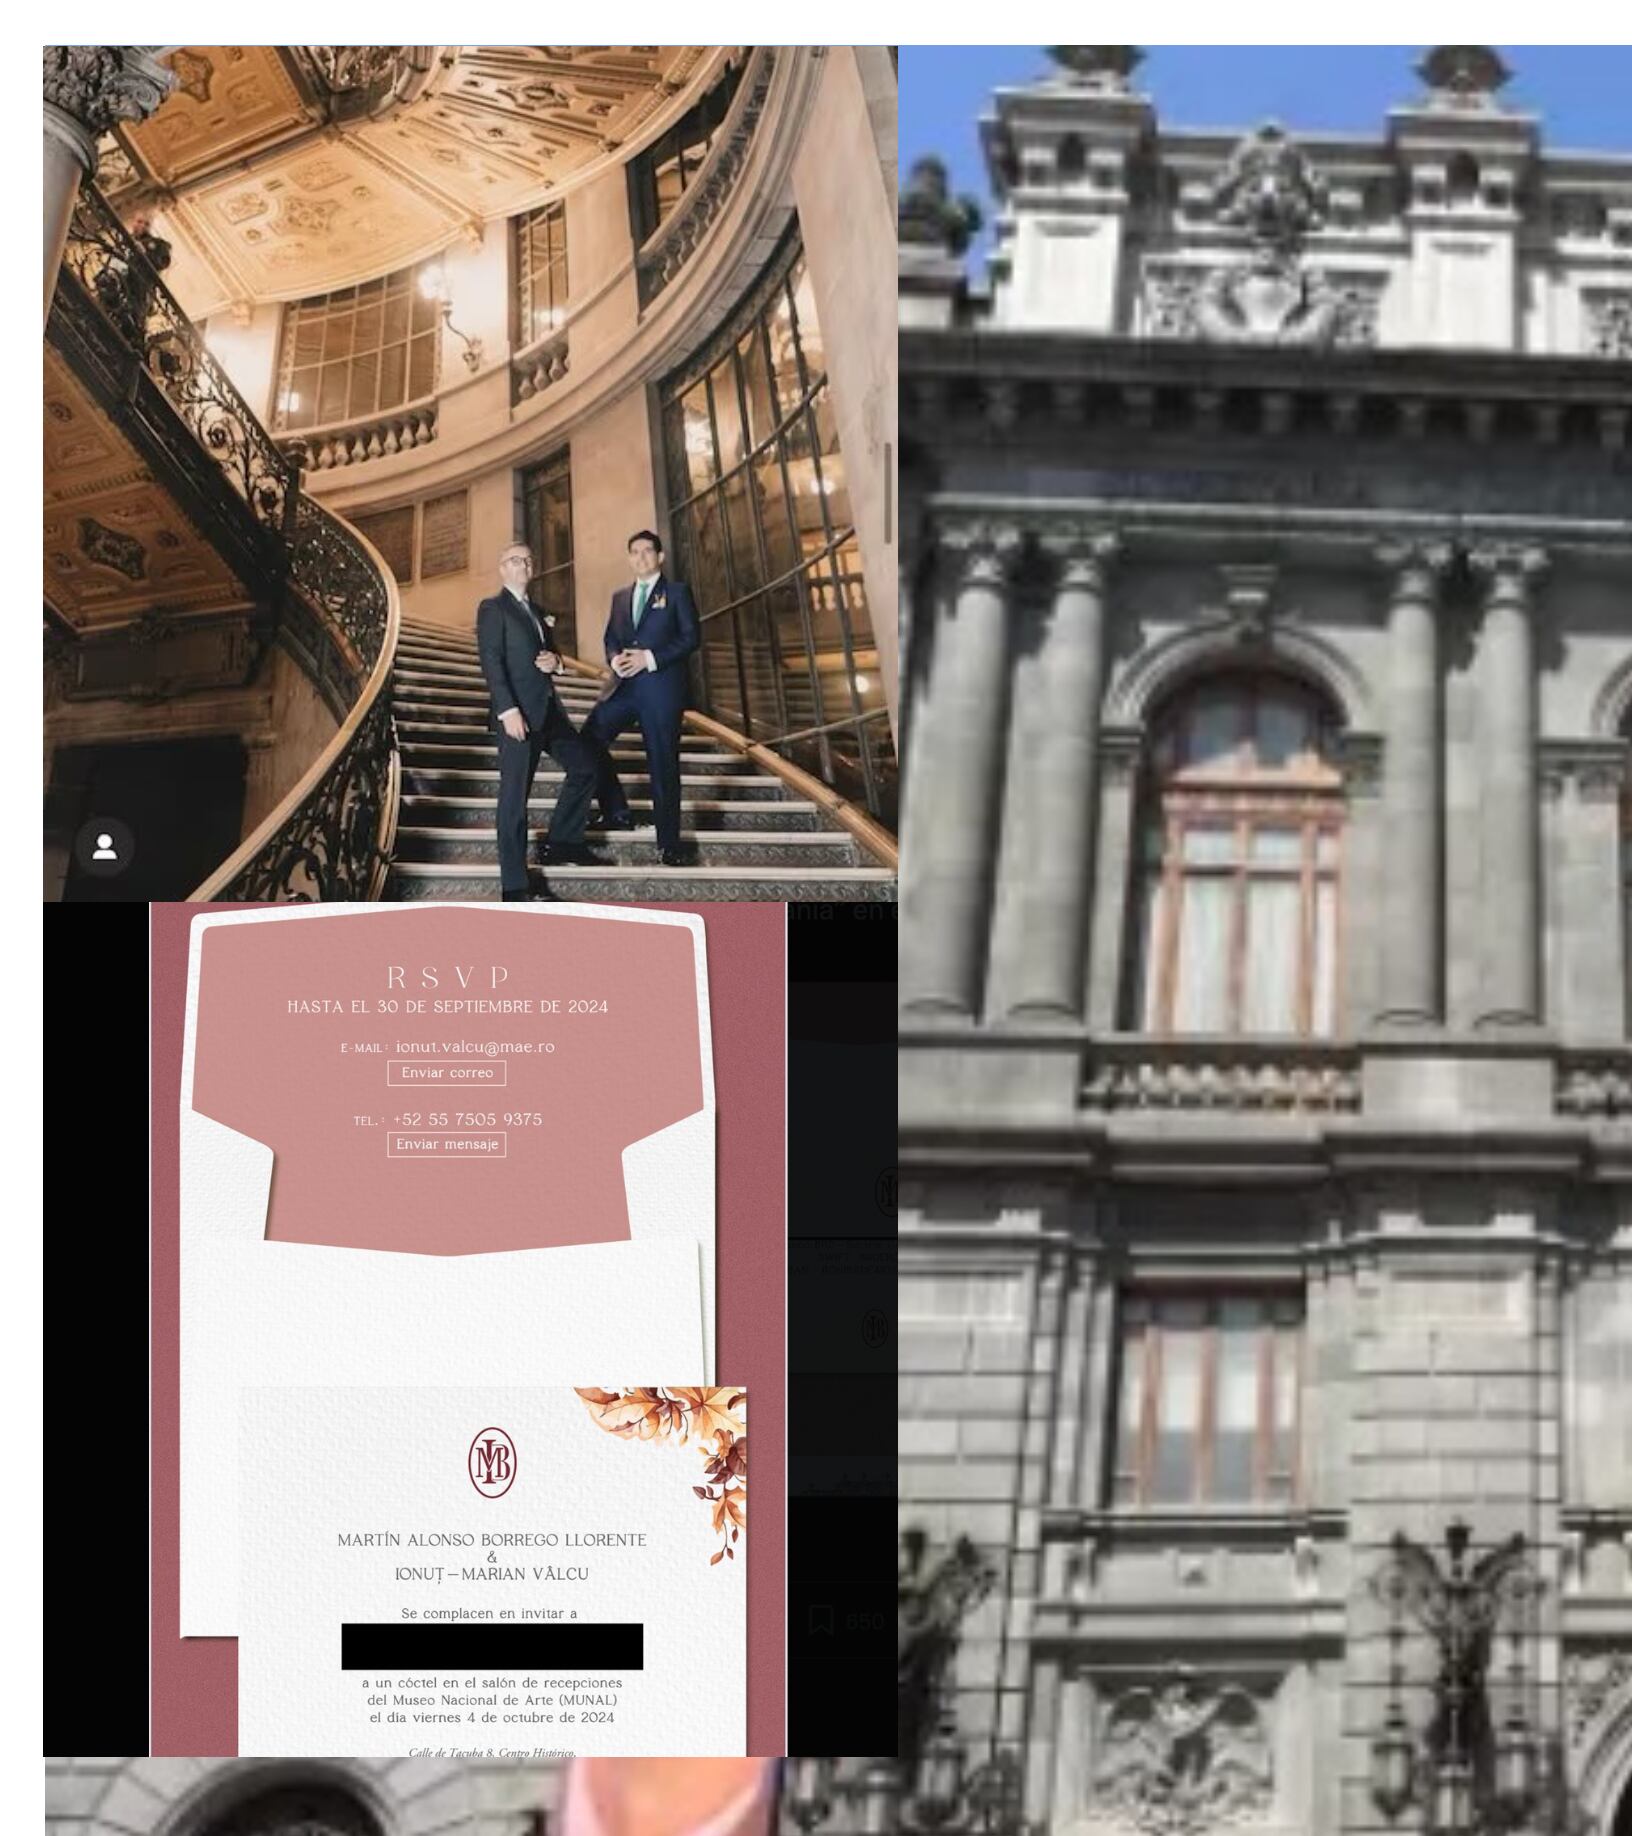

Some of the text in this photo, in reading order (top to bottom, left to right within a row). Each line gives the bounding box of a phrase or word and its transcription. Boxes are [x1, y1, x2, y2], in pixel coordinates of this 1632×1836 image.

[287, 999, 609, 1014] HASTA EL 30 DE SEPTIEMBRE DE 2024
[396, 1039, 555, 1057] ionut.valcu@mae.ro
[402, 1066, 494, 1080] Enviar correo
[393, 1112, 422, 1126] +52
[428, 1112, 449, 1126] 55
[455, 1112, 496, 1127] 7505
[503, 1112, 543, 1126] 9375
[396, 1138, 499, 1152] Enviar mensaje
[338, 1530, 647, 1547] MARTÍN ALONSO BORREGO LLORENTE
[486, 1550, 497, 1564] &
[532, 1565, 589, 1581] VÂLCU
[401, 1607, 578, 1622] Se complacen en invitar a
[362, 1676, 623, 1692] a un cóctel en el salón de recepciones
[367, 1694, 618, 1707] del Museo Nacional de Arte (MUNAL)
[369, 1711, 381, 1723] el
[412, 1711, 461, 1723] viernes
[467, 1711, 476, 1723] 4
[481, 1711, 497, 1723] de
[502, 1711, 554, 1724] octubre
[559, 1711, 576, 1723] de
[581, 1711, 615, 1723] 2024
[408, 1747, 434, 1757] Calle
[435, 1747, 447, 1757] de
[450, 1747, 484, 1757] Tacuba
[498, 1747, 530, 1757] Centro
